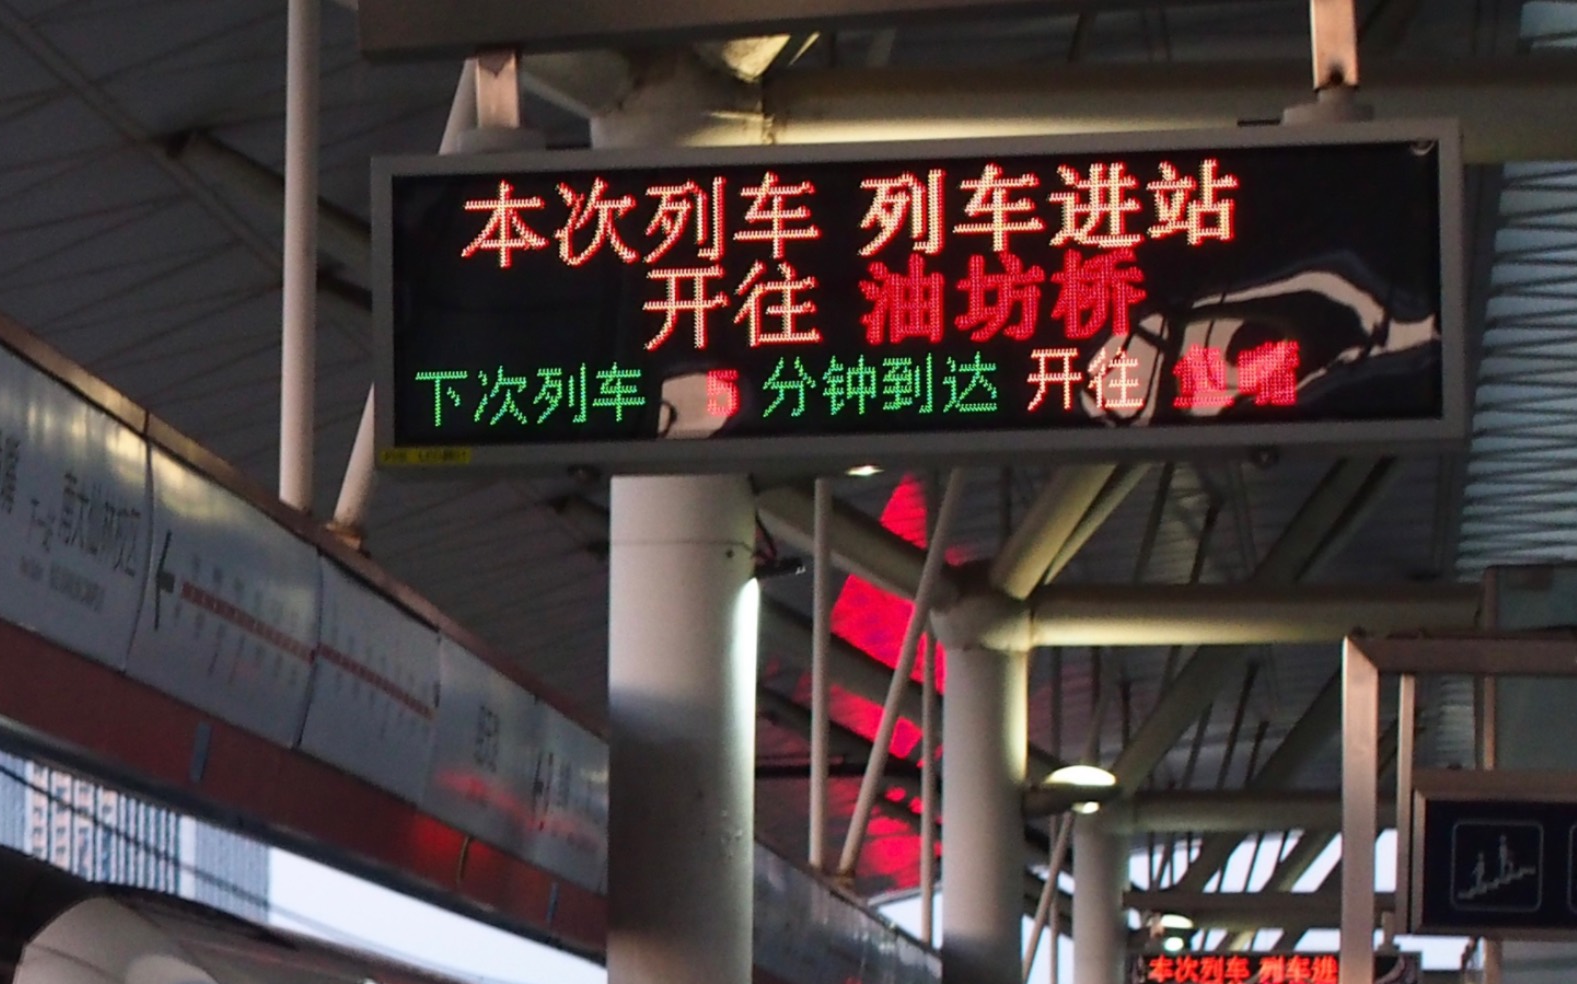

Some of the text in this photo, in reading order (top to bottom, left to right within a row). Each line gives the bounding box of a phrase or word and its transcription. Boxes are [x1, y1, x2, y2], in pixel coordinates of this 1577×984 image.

[461, 159, 1239, 267] 本次列车 列车进站
[643, 246, 1146, 350] 开往 油坊桥
[415, 363, 646, 427] 下次列车
[763, 352, 999, 418] 分钟到达
[1027, 347, 1144, 412] 开往
[1147, 954, 1251, 984] 本次列车
